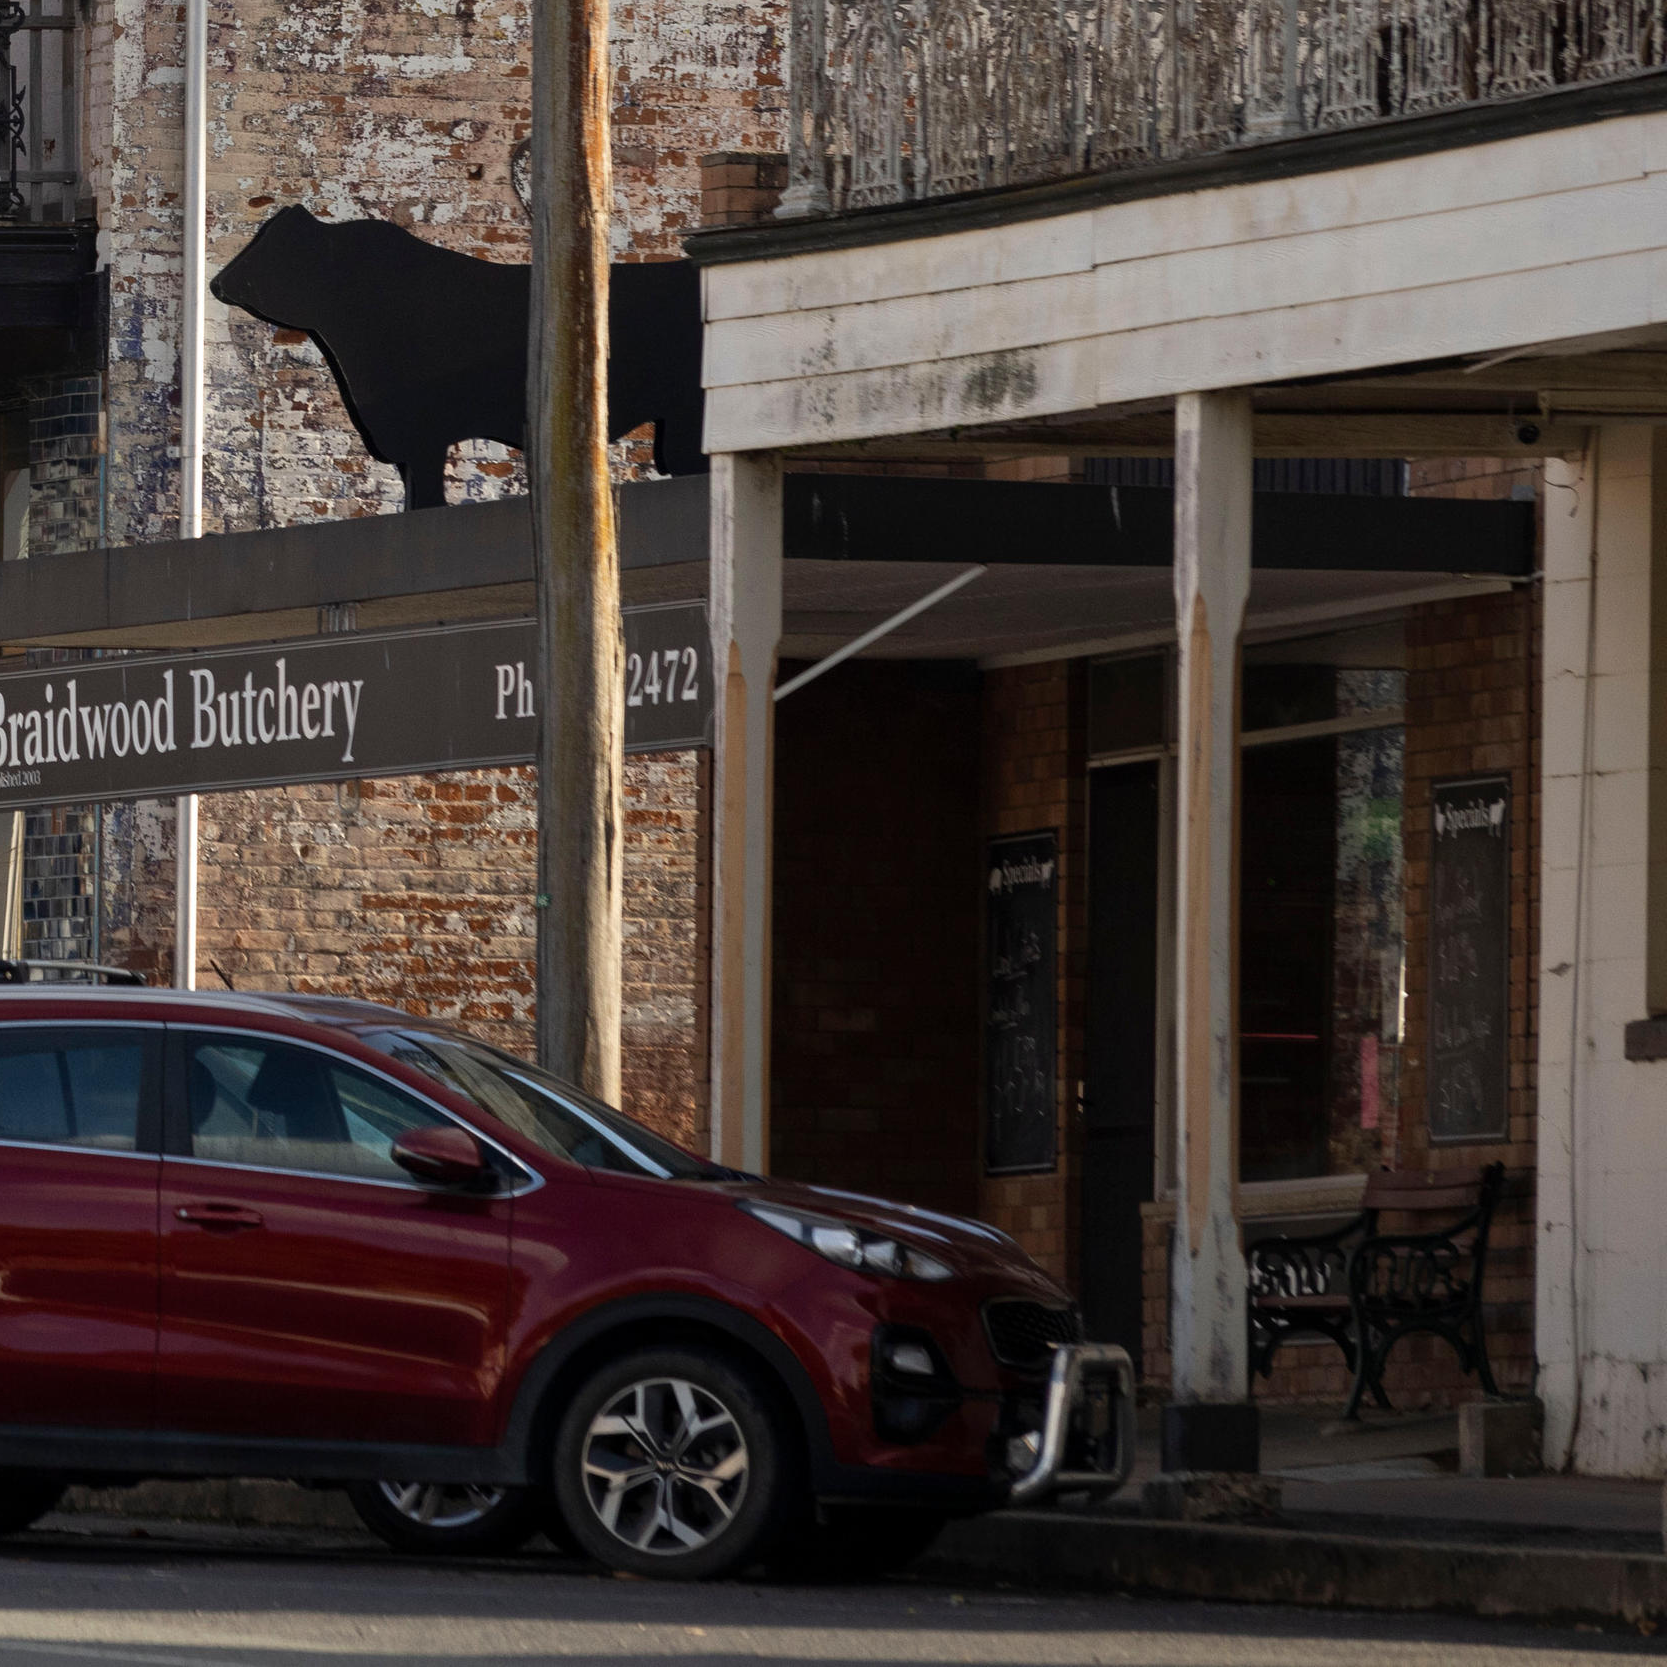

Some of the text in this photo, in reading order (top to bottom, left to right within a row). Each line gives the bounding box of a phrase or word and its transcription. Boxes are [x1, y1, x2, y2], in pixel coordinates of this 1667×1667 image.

[189, 657, 364, 763] Butchery
[494, 646, 700, 720] Ph 2472
[1446, 797, 1490, 839] Specials
[1003, 855, 1043, 893] Specials
